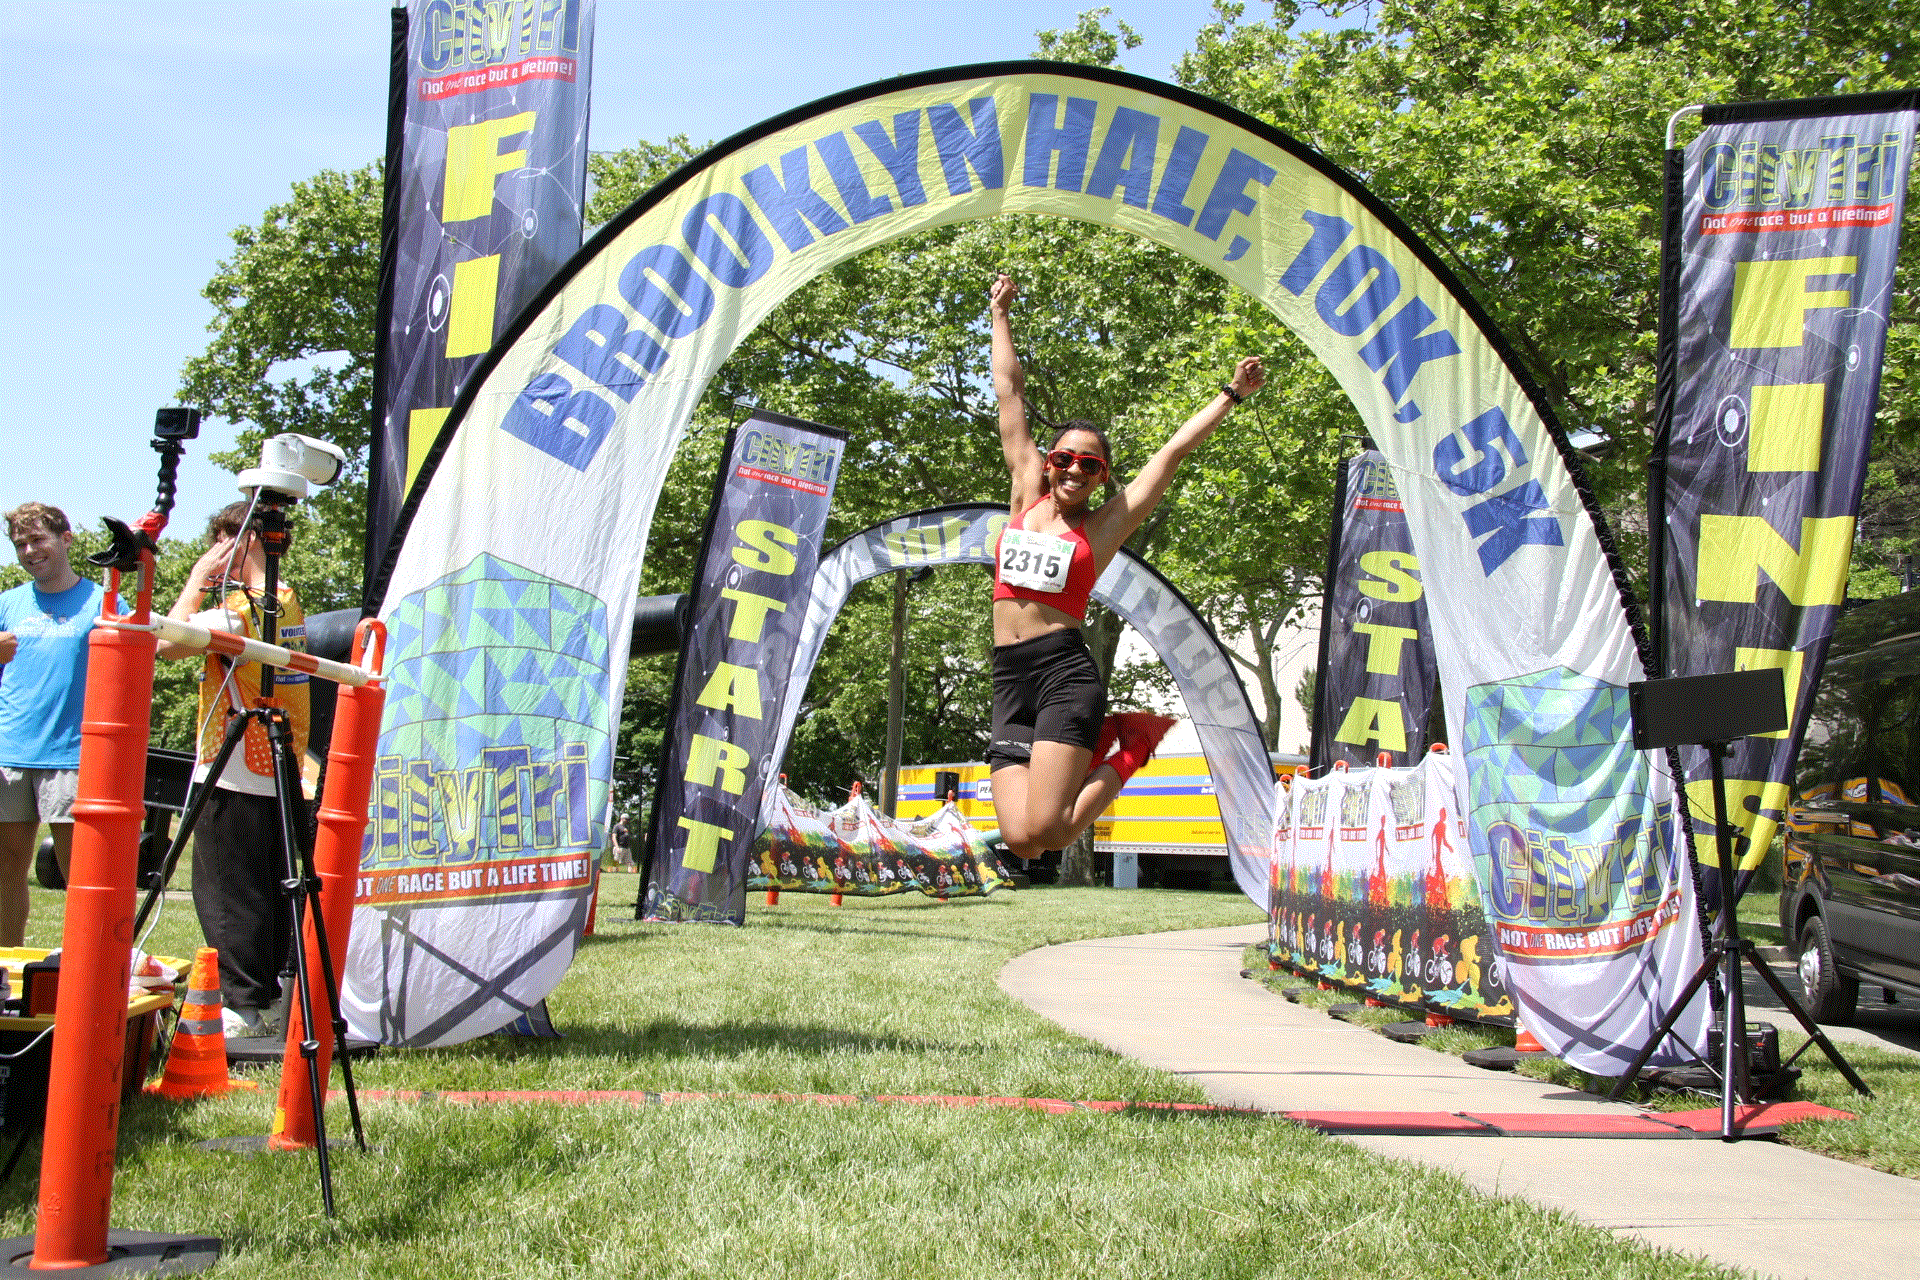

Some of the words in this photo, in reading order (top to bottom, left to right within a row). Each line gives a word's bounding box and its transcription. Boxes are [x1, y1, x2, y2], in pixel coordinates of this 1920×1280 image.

[463, 74, 487, 88] race
[488, 67, 509, 83] but
[511, 67, 519, 79] a
[1700, 132, 1901, 210] CityTri
[1753, 213, 1784, 227] race
[1789, 213, 1814, 226] but
[1817, 212, 1828, 222] a
[1832, 206, 1890, 222] lifetime!
[500, 95, 1003, 473] BROOKLYN
[1022, 93, 1277, 262] HALF,
[1278, 209, 1463, 424] 10K,
[1433, 405, 1566, 578] 5K
[741, 430, 837, 483] CityTri
[763, 472, 780, 483] race
[1003, 548, 1061, 579] 2315
[1334, 551, 1424, 753] STA
[677, 519, 799, 876] START
[356, 877, 374, 898] OT
[376, 876, 396, 894] ONE
[397, 872, 445, 894] RACE
[449, 868, 483, 891] BUT
[487, 867, 500, 886] A
[502, 863, 537, 885] LIFE
[542, 859, 588, 881] TIME!
[1499, 926, 1528, 948] NOT
[1529, 934, 1544, 949] ONE
[1544, 932, 1586, 950] RACE
[1588, 928, 1621, 946] BUT
